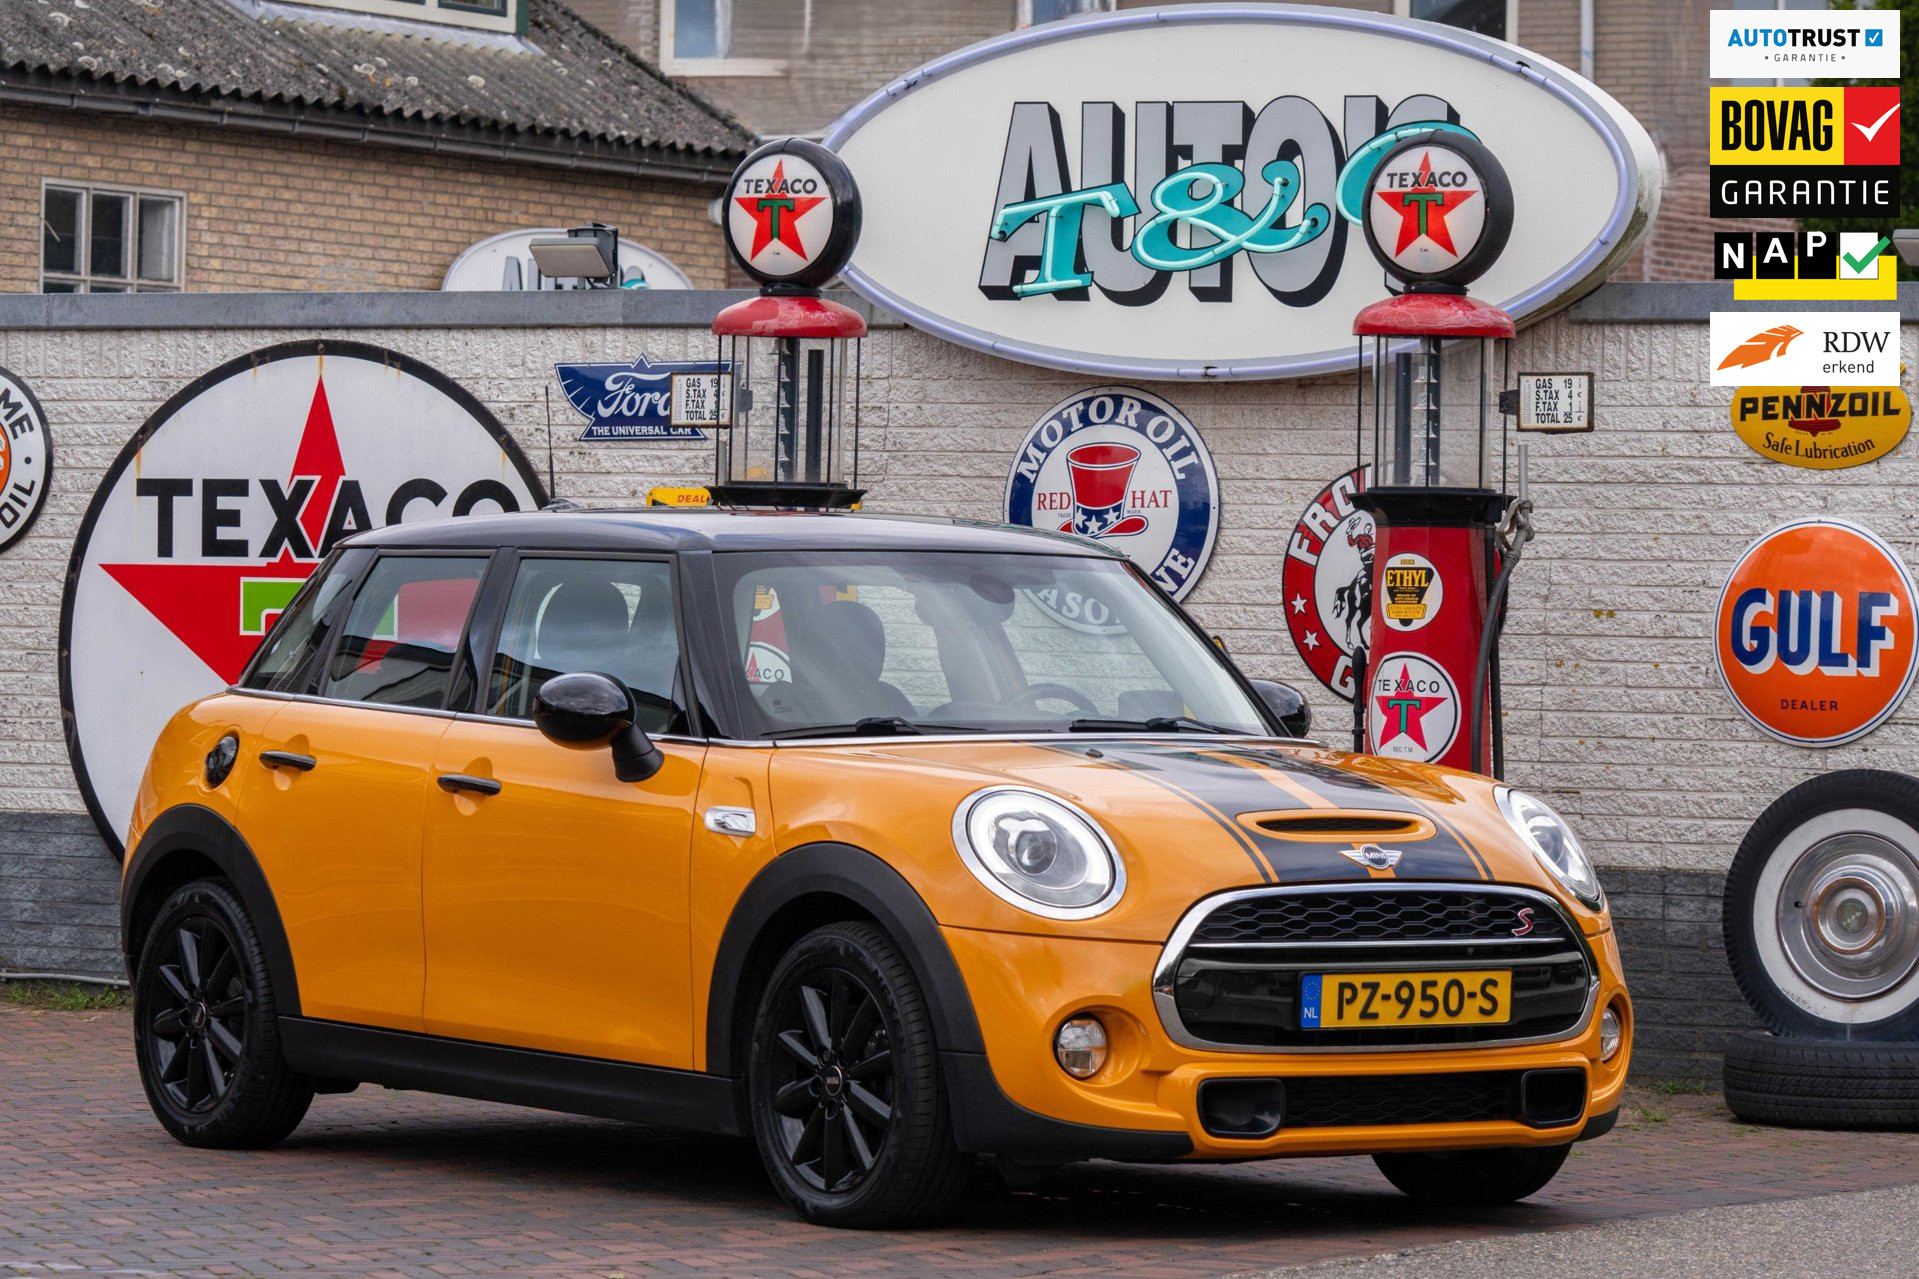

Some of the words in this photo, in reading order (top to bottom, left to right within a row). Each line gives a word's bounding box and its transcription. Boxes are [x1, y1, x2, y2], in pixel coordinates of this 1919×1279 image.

[744, 178, 818, 194] TEXACO
[1386, 171, 1468, 188] TEXACO
[978, 95, 1460, 307] AUTO'
[685, 377, 701, 389] GAS
[1535, 378, 1553, 390] GAS
[1563, 378, 1573, 389] 19
[685, 388, 707, 399] S.TAX
[1535, 390, 1560, 401] S.TAX
[1567, 390, 1573, 400] 4
[685, 399, 706, 410] F.TAX
[1535, 401, 1558, 413] F.TAX
[1569, 401, 1573, 411] 1
[1739, 391, 1901, 421] PENNZOIL
[685, 410, 707, 420] TOTAL
[1535, 412, 1561, 424] TOTAL
[1563, 412, 1573, 423] 25
[592, 426, 610, 436] THE
[612, 426, 667, 436] UNIVERSAL
[1017, 396, 1142, 484] MOTOR
[1146, 415, 1199, 480] OIL
[1762, 431, 1792, 455] Safe
[1795, 437, 1876, 460] Lubrication
[0, 480, 36, 529] OIL
[677, 495, 709, 503] DEAL
[1037, 493, 1071, 510] RED
[1131, 490, 1172, 508] HAT
[1387, 569, 1429, 587] ETHYL
[1731, 587, 1899, 677] GULF
[1378, 679, 1440, 692] TEXACO
[1780, 699, 1839, 711] DEALER
[1511, 907, 1534, 936] S
[1303, 1007, 1318, 1019] NL
[1337, 978, 1499, 1021] PZ-950-S
